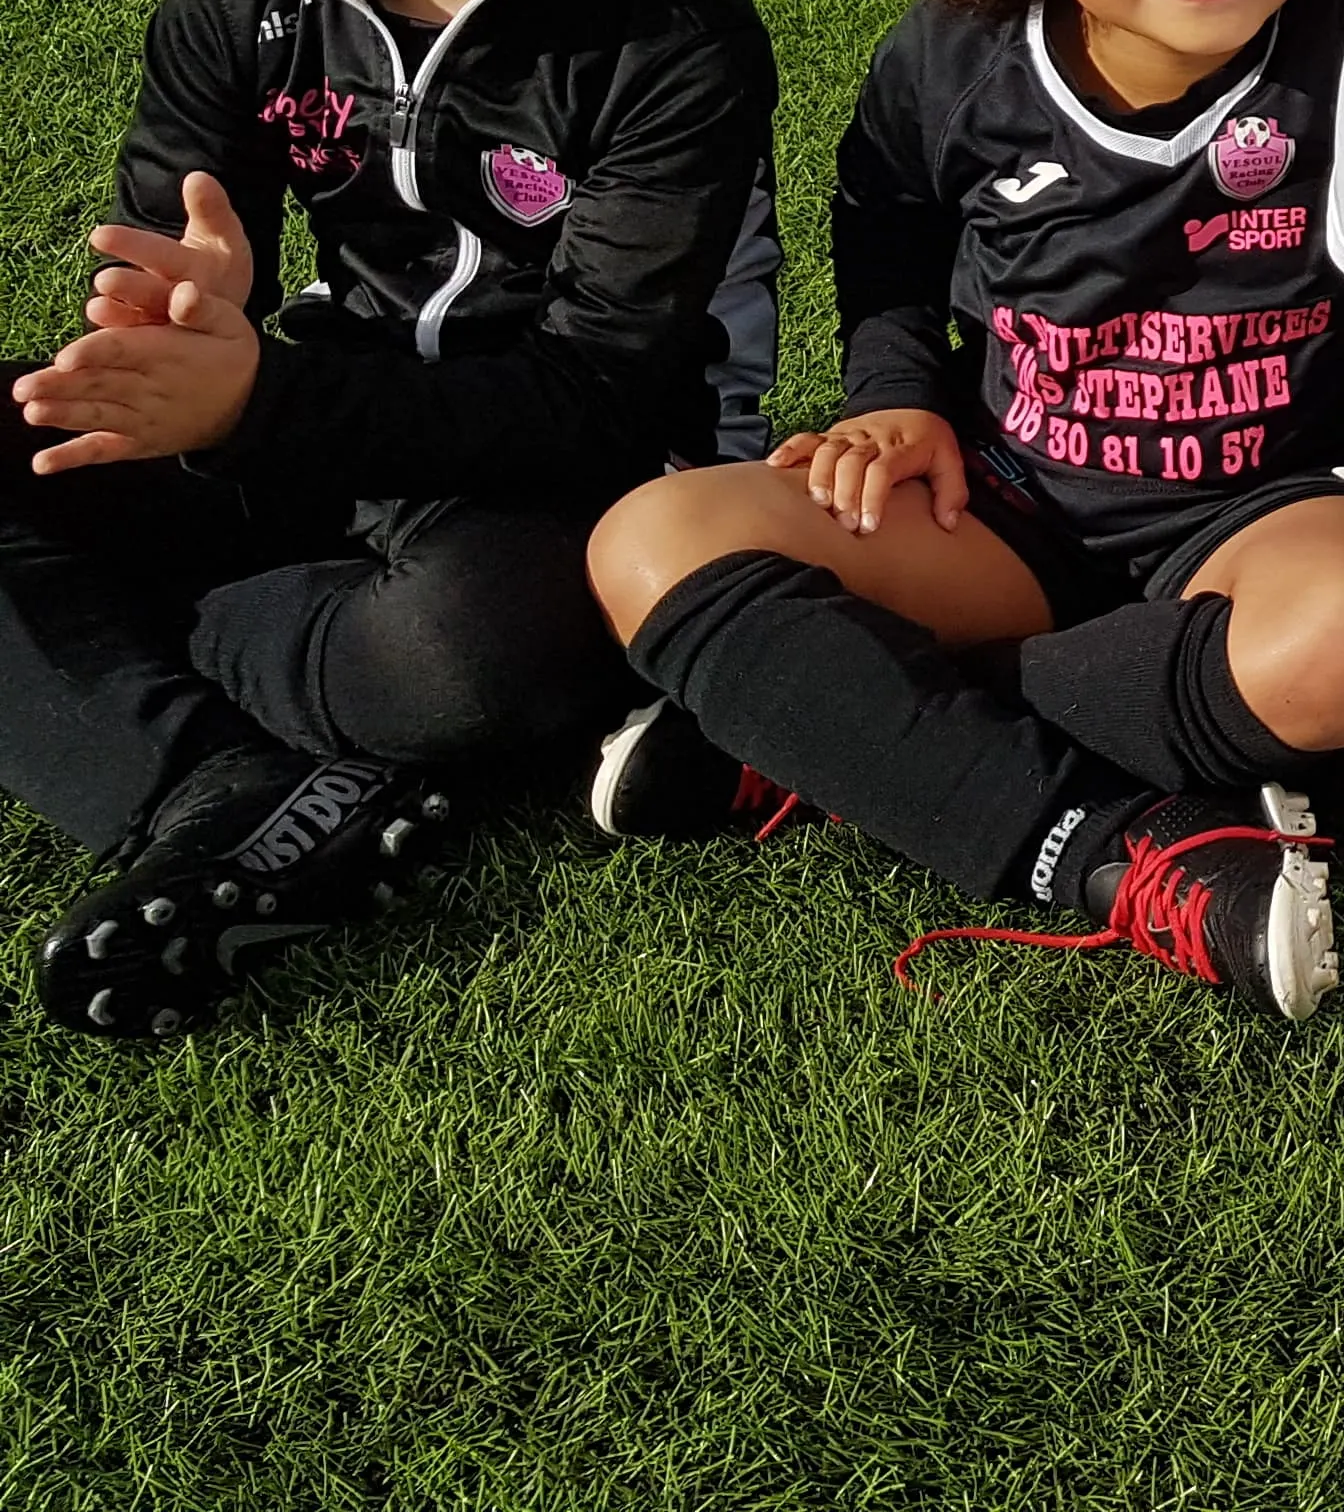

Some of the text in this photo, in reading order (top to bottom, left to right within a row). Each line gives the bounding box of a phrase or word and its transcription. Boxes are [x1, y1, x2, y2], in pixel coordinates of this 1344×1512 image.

[1222, 155, 1283, 169] VESOUL
[1229, 167, 1275, 180] Racing
[1236, 177, 1266, 188] Club
[513, 192, 548, 203] Club
[1231, 206, 1307, 229] INTER
[1228, 226, 1305, 251] SPORT
[1073, 354, 1291, 422] STEPHANE
[1005, 391, 1265, 480] 06 30 81 10 57
